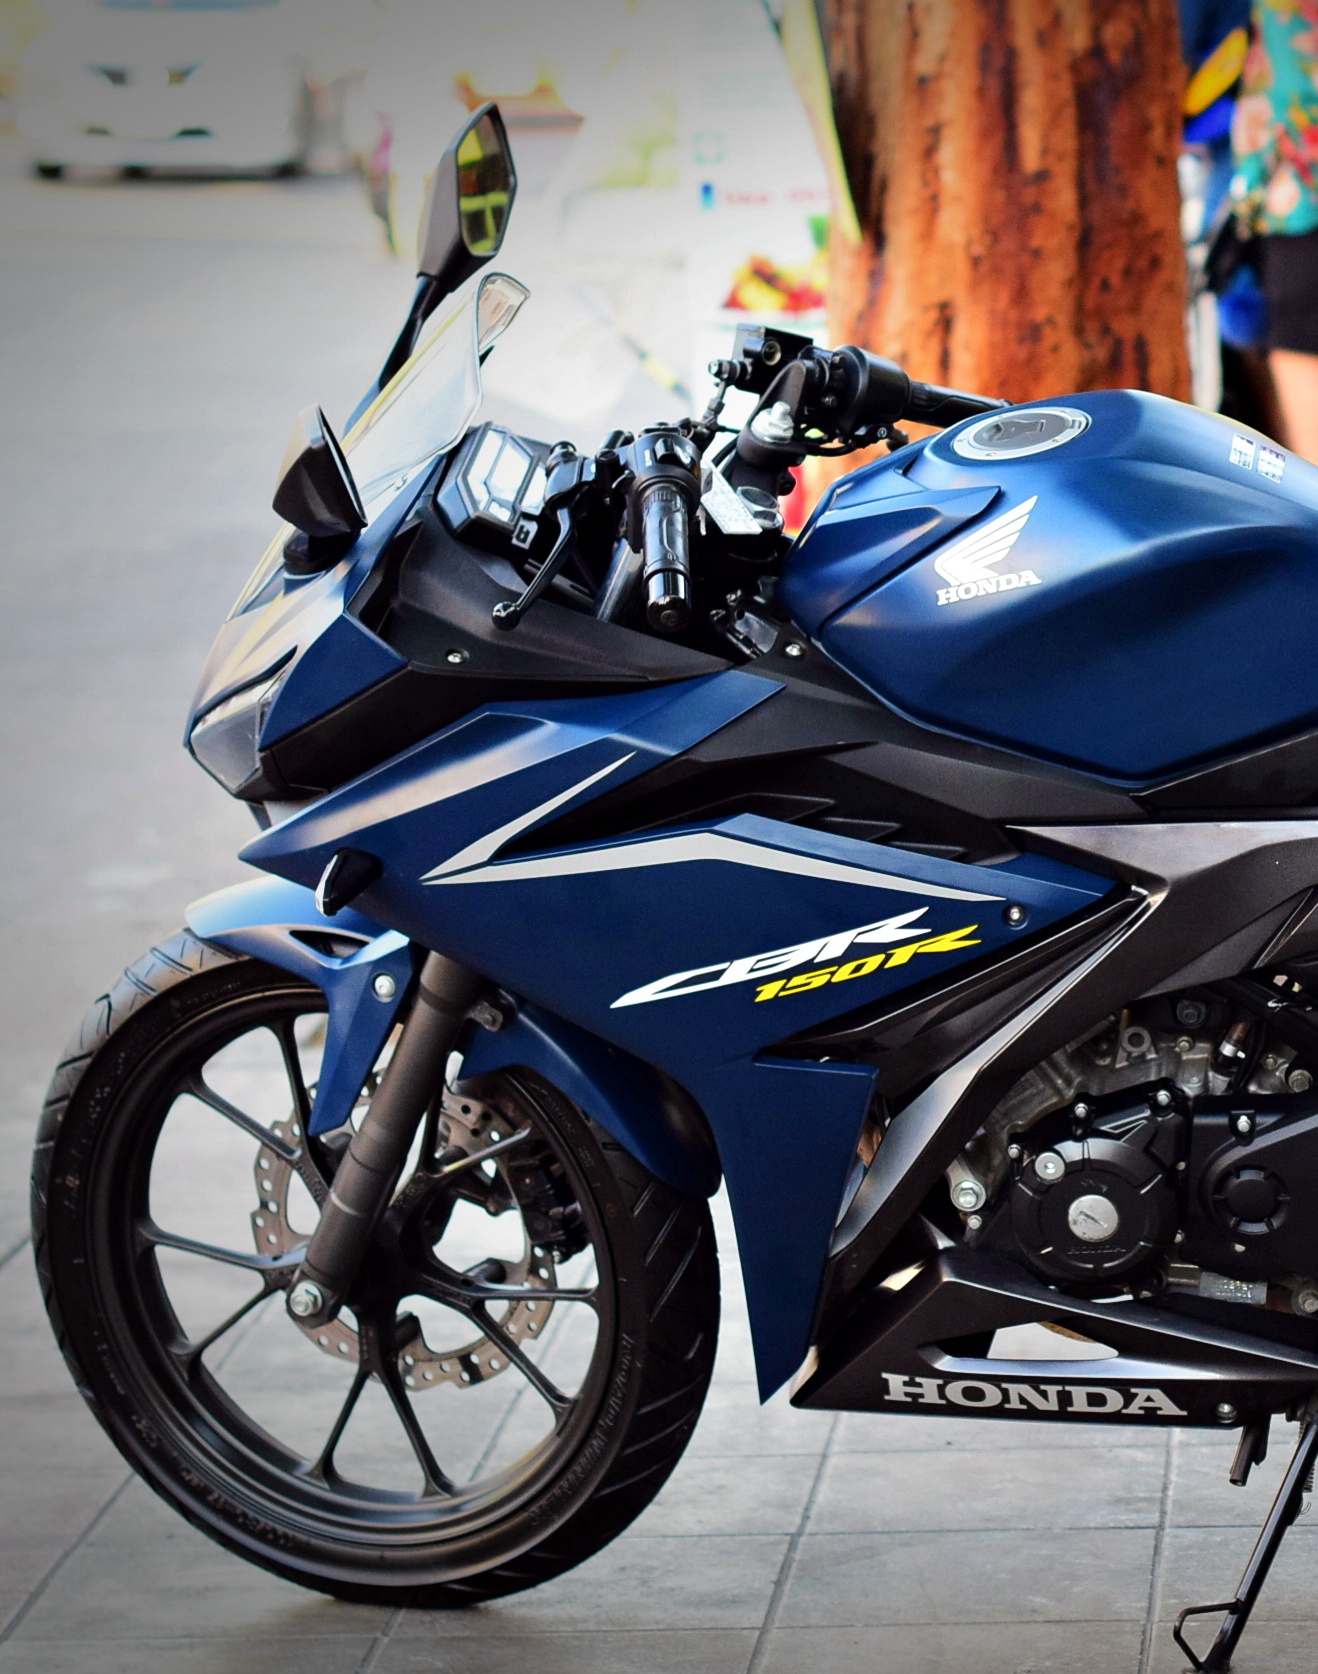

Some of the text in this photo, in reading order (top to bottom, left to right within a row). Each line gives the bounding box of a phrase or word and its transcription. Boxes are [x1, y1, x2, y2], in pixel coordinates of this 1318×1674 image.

[935, 569, 1042, 606] HONDA
[609, 906, 932, 1009] CBR
[754, 924, 982, 1003] 150R
[881, 1372, 1188, 1416] HONDA
